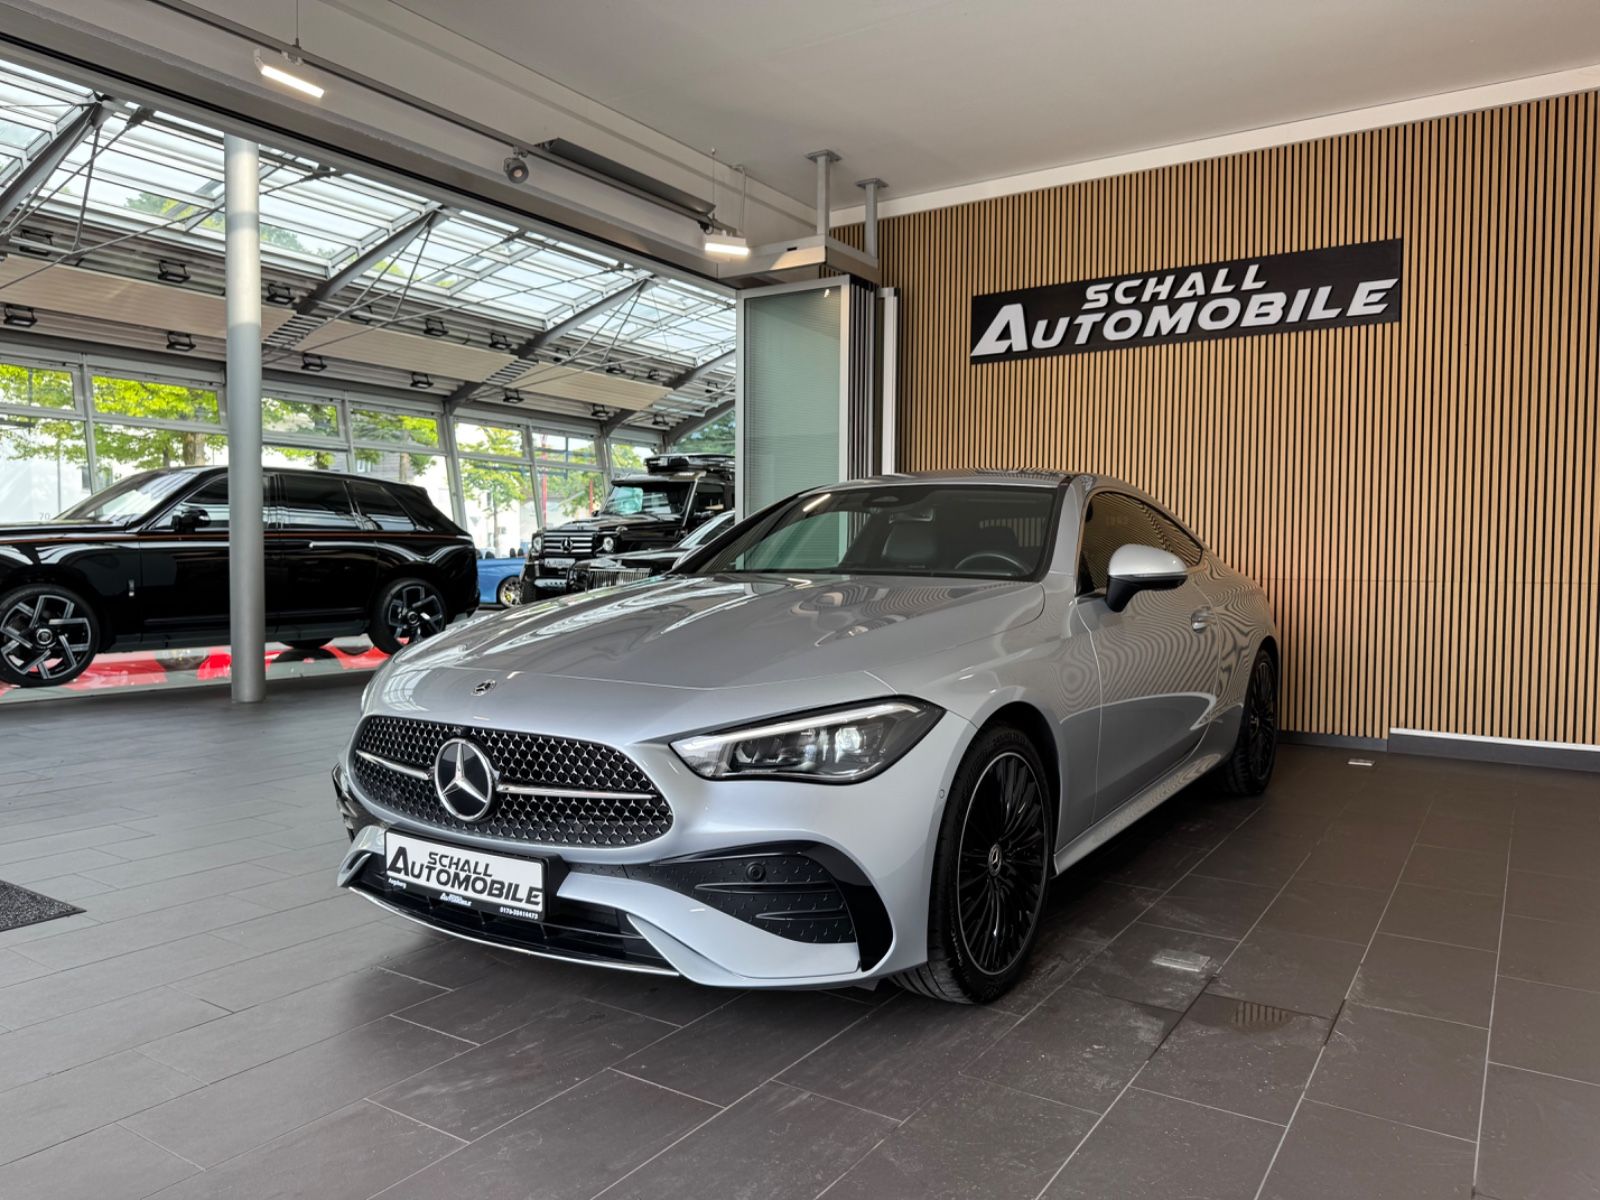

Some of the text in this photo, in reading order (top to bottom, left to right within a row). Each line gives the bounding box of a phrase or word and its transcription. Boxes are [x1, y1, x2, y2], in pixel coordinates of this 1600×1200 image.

[1081, 264, 1267, 309] SCHALL
[970, 278, 1399, 357] AUTOMOBILE
[386, 846, 544, 906] AUTOMOBILE
[427, 851, 493, 877] SCHALL
